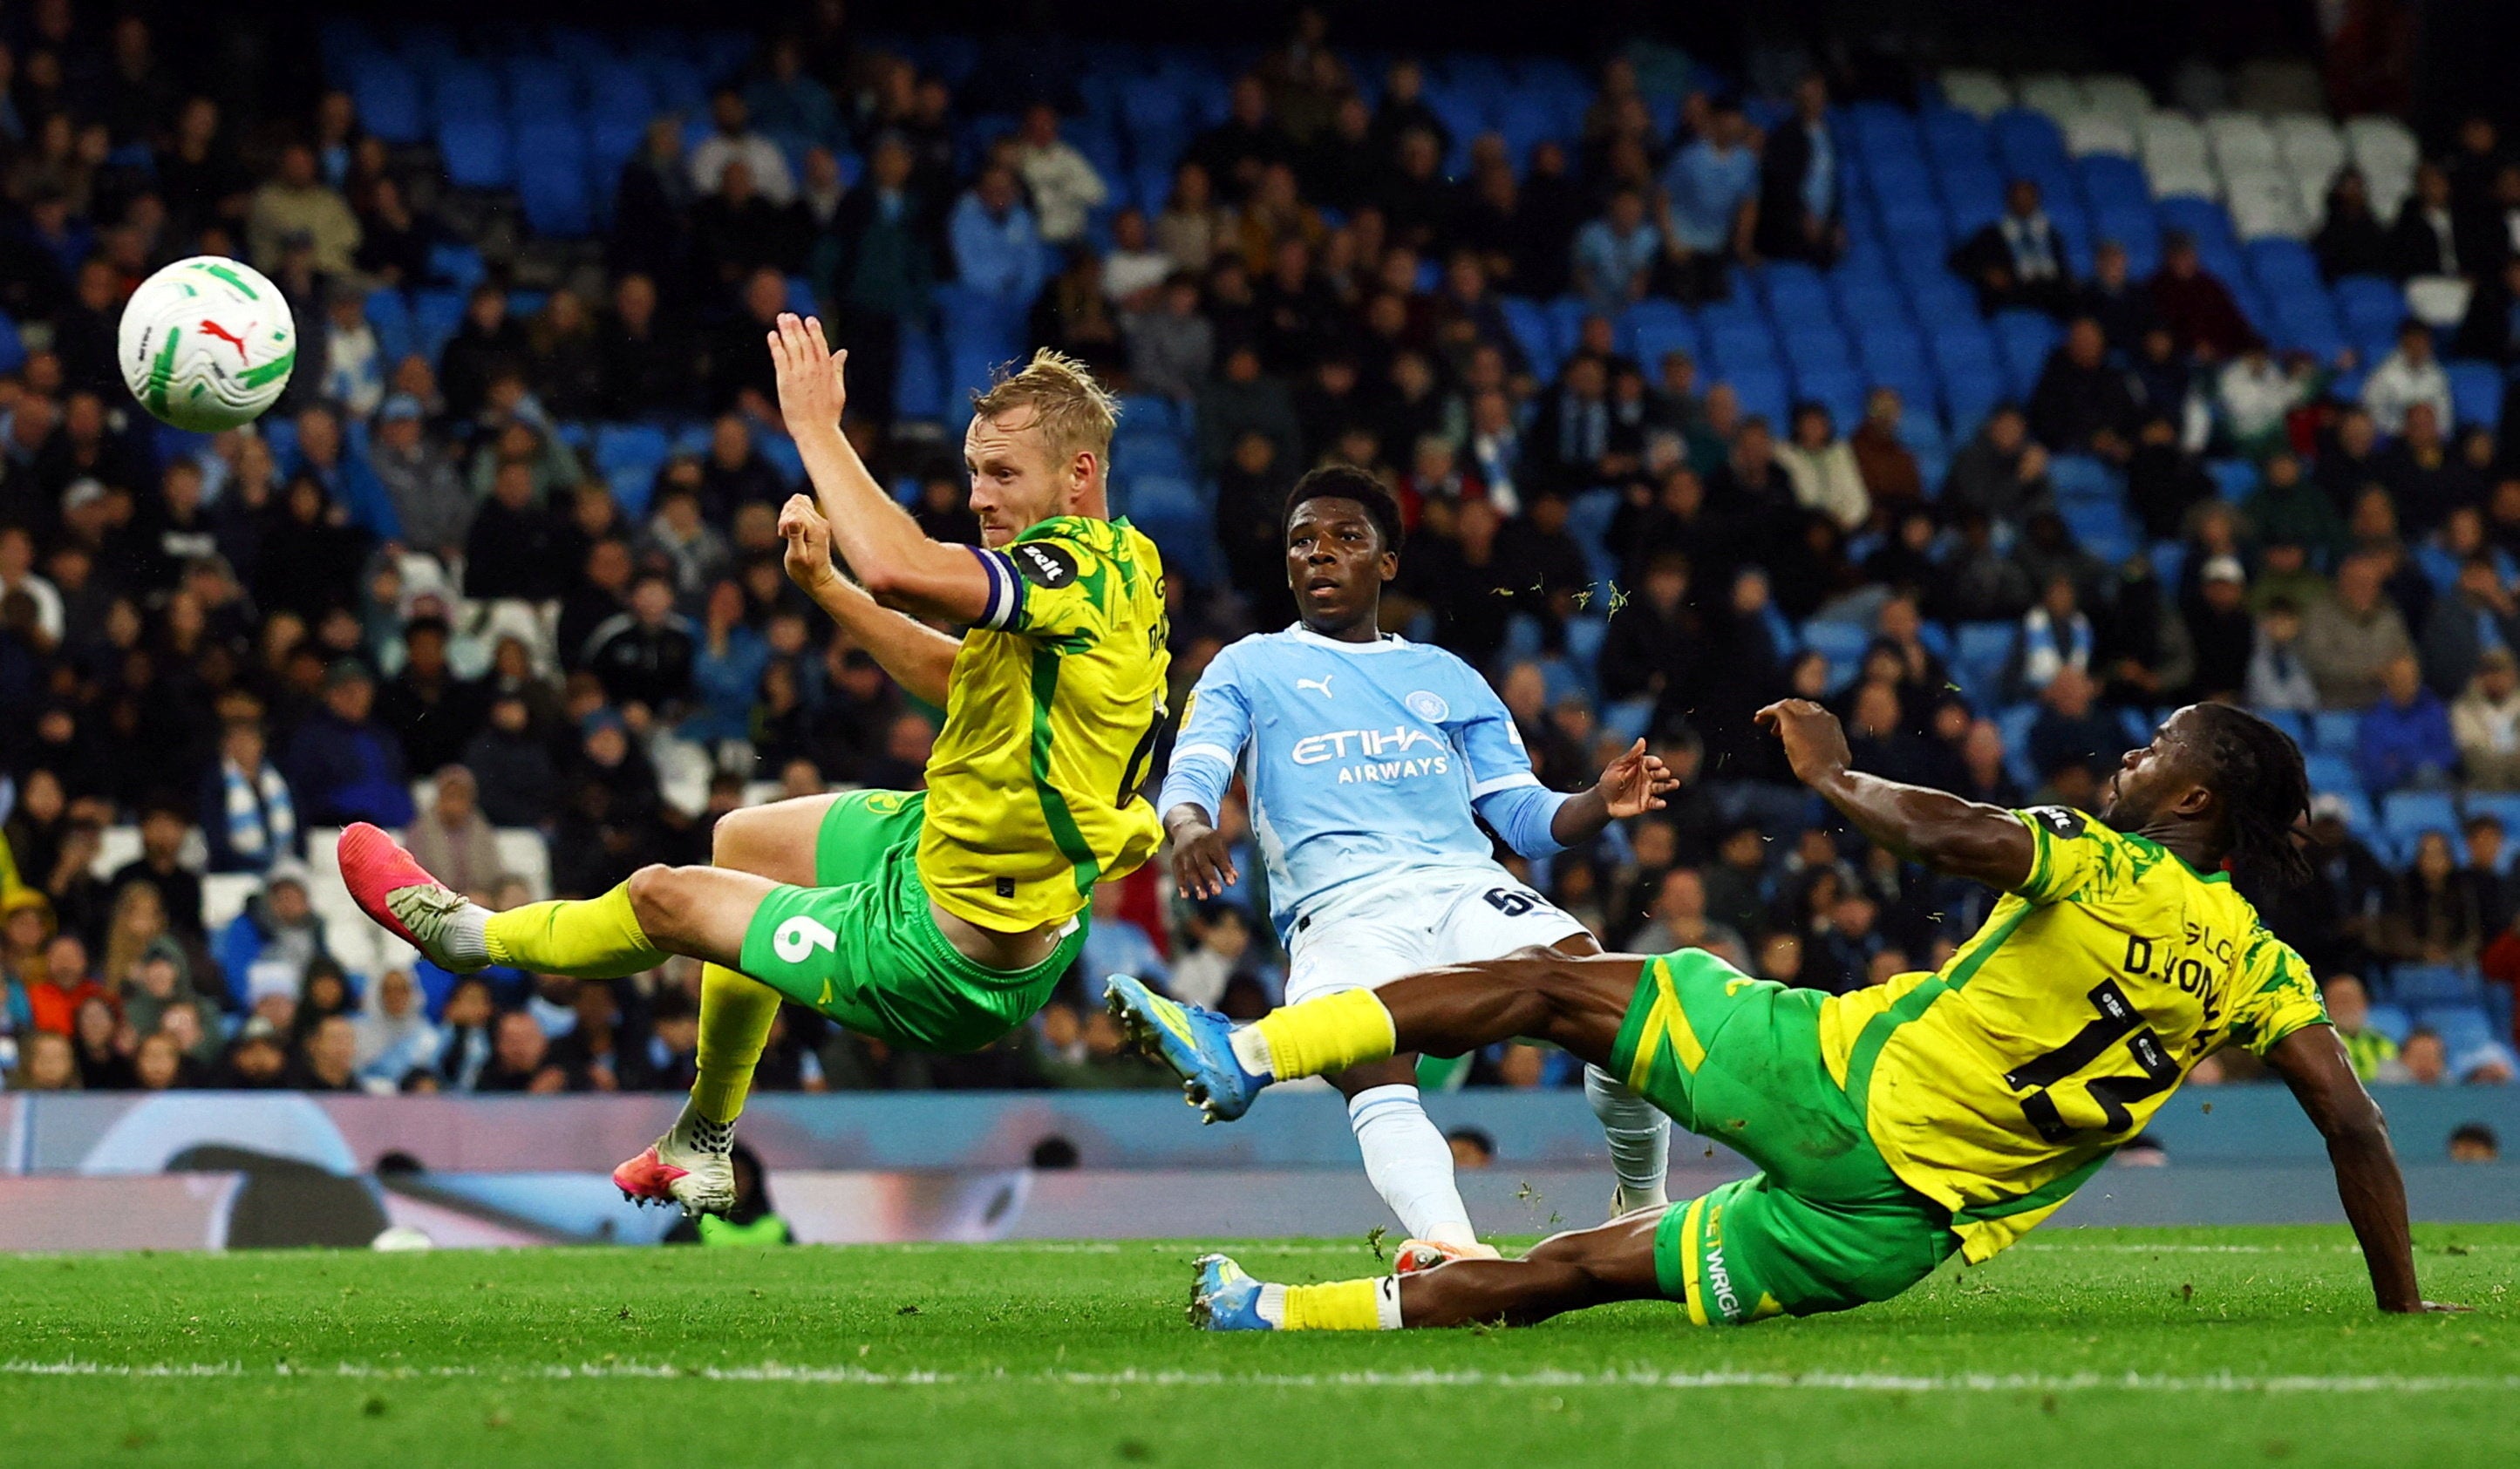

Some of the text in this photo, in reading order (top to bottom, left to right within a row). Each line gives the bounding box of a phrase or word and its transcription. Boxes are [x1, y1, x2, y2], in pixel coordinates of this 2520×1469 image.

[1022, 545, 1064, 581] zelt
[1291, 724, 1449, 765] ETIHA
[1338, 756, 1448, 785] AIRWAYS
[773, 915, 837, 963] 6
[2004, 976, 2183, 1144] 13
